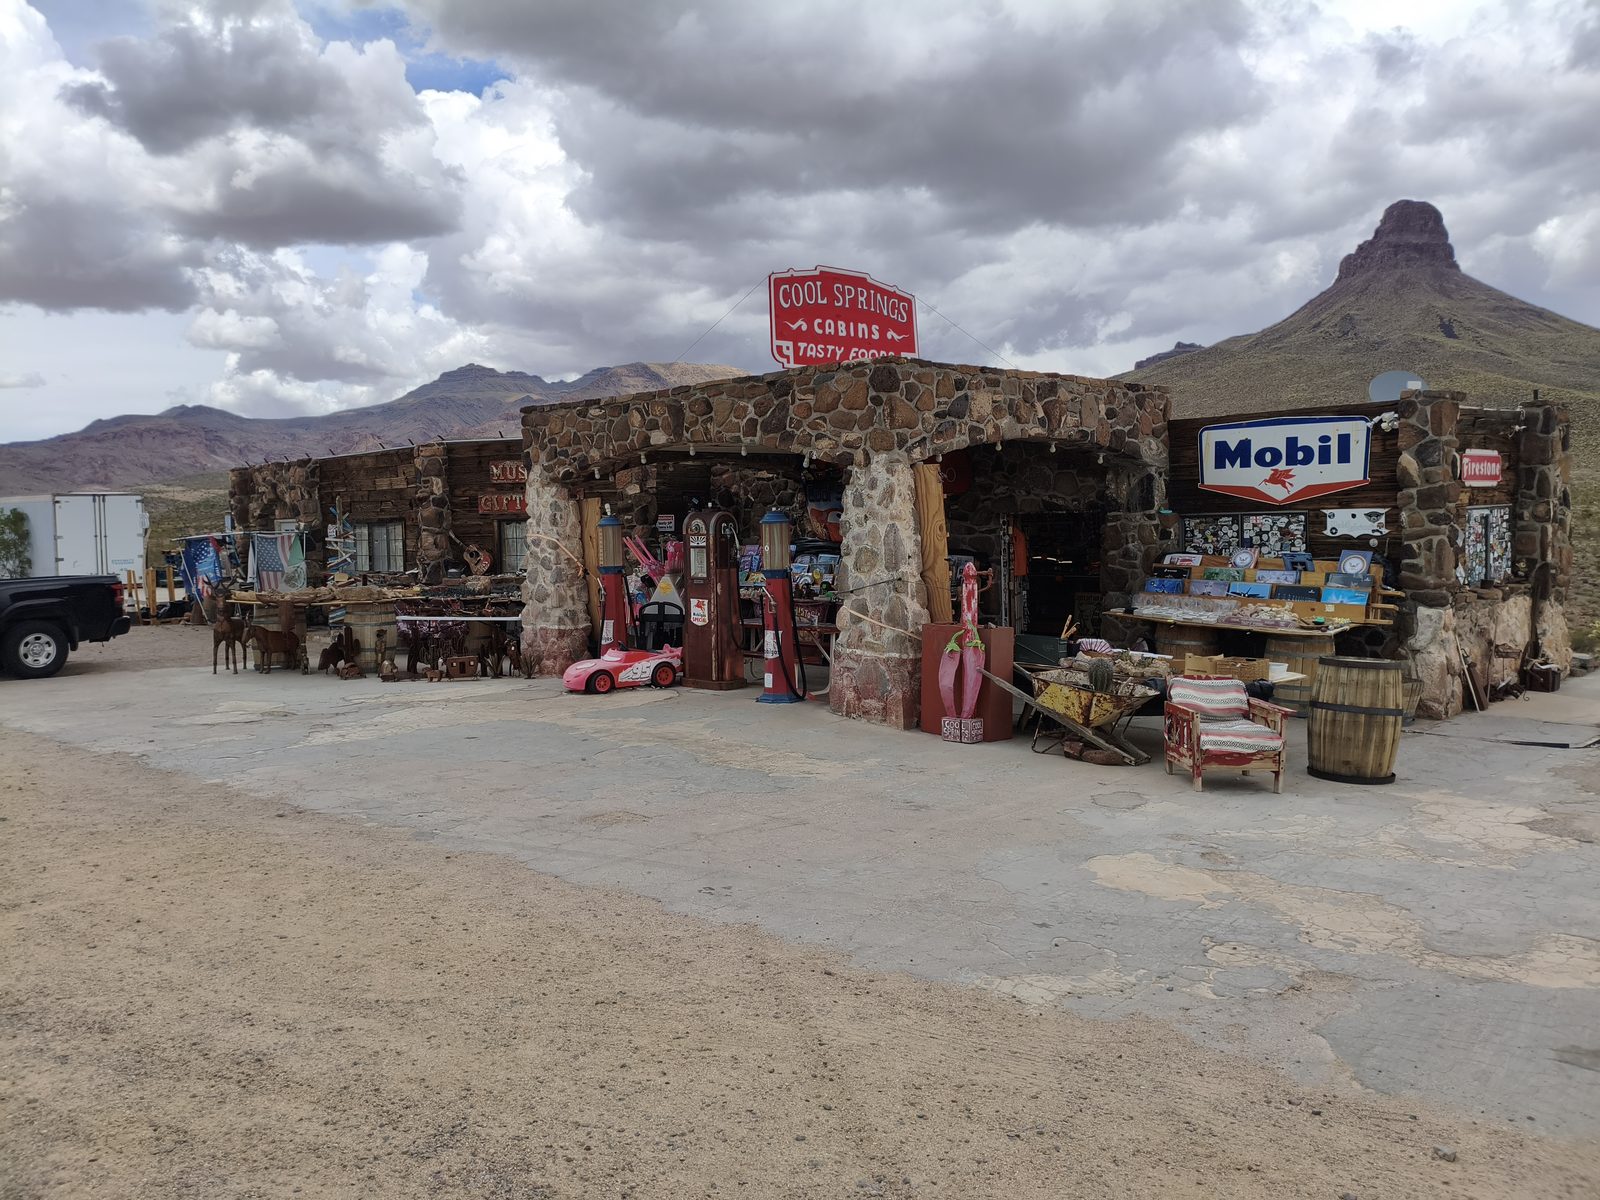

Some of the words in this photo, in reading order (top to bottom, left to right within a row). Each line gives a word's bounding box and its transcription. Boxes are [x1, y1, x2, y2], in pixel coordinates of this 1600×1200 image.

[779, 281, 828, 309] COOL
[833, 283, 909, 323] SPRINGS
[797, 342, 844, 361] TASTY
[1214, 433, 1351, 470] Mobil
[1462, 457, 1500, 478] Firestone
[632, 661, 651, 680] 95
